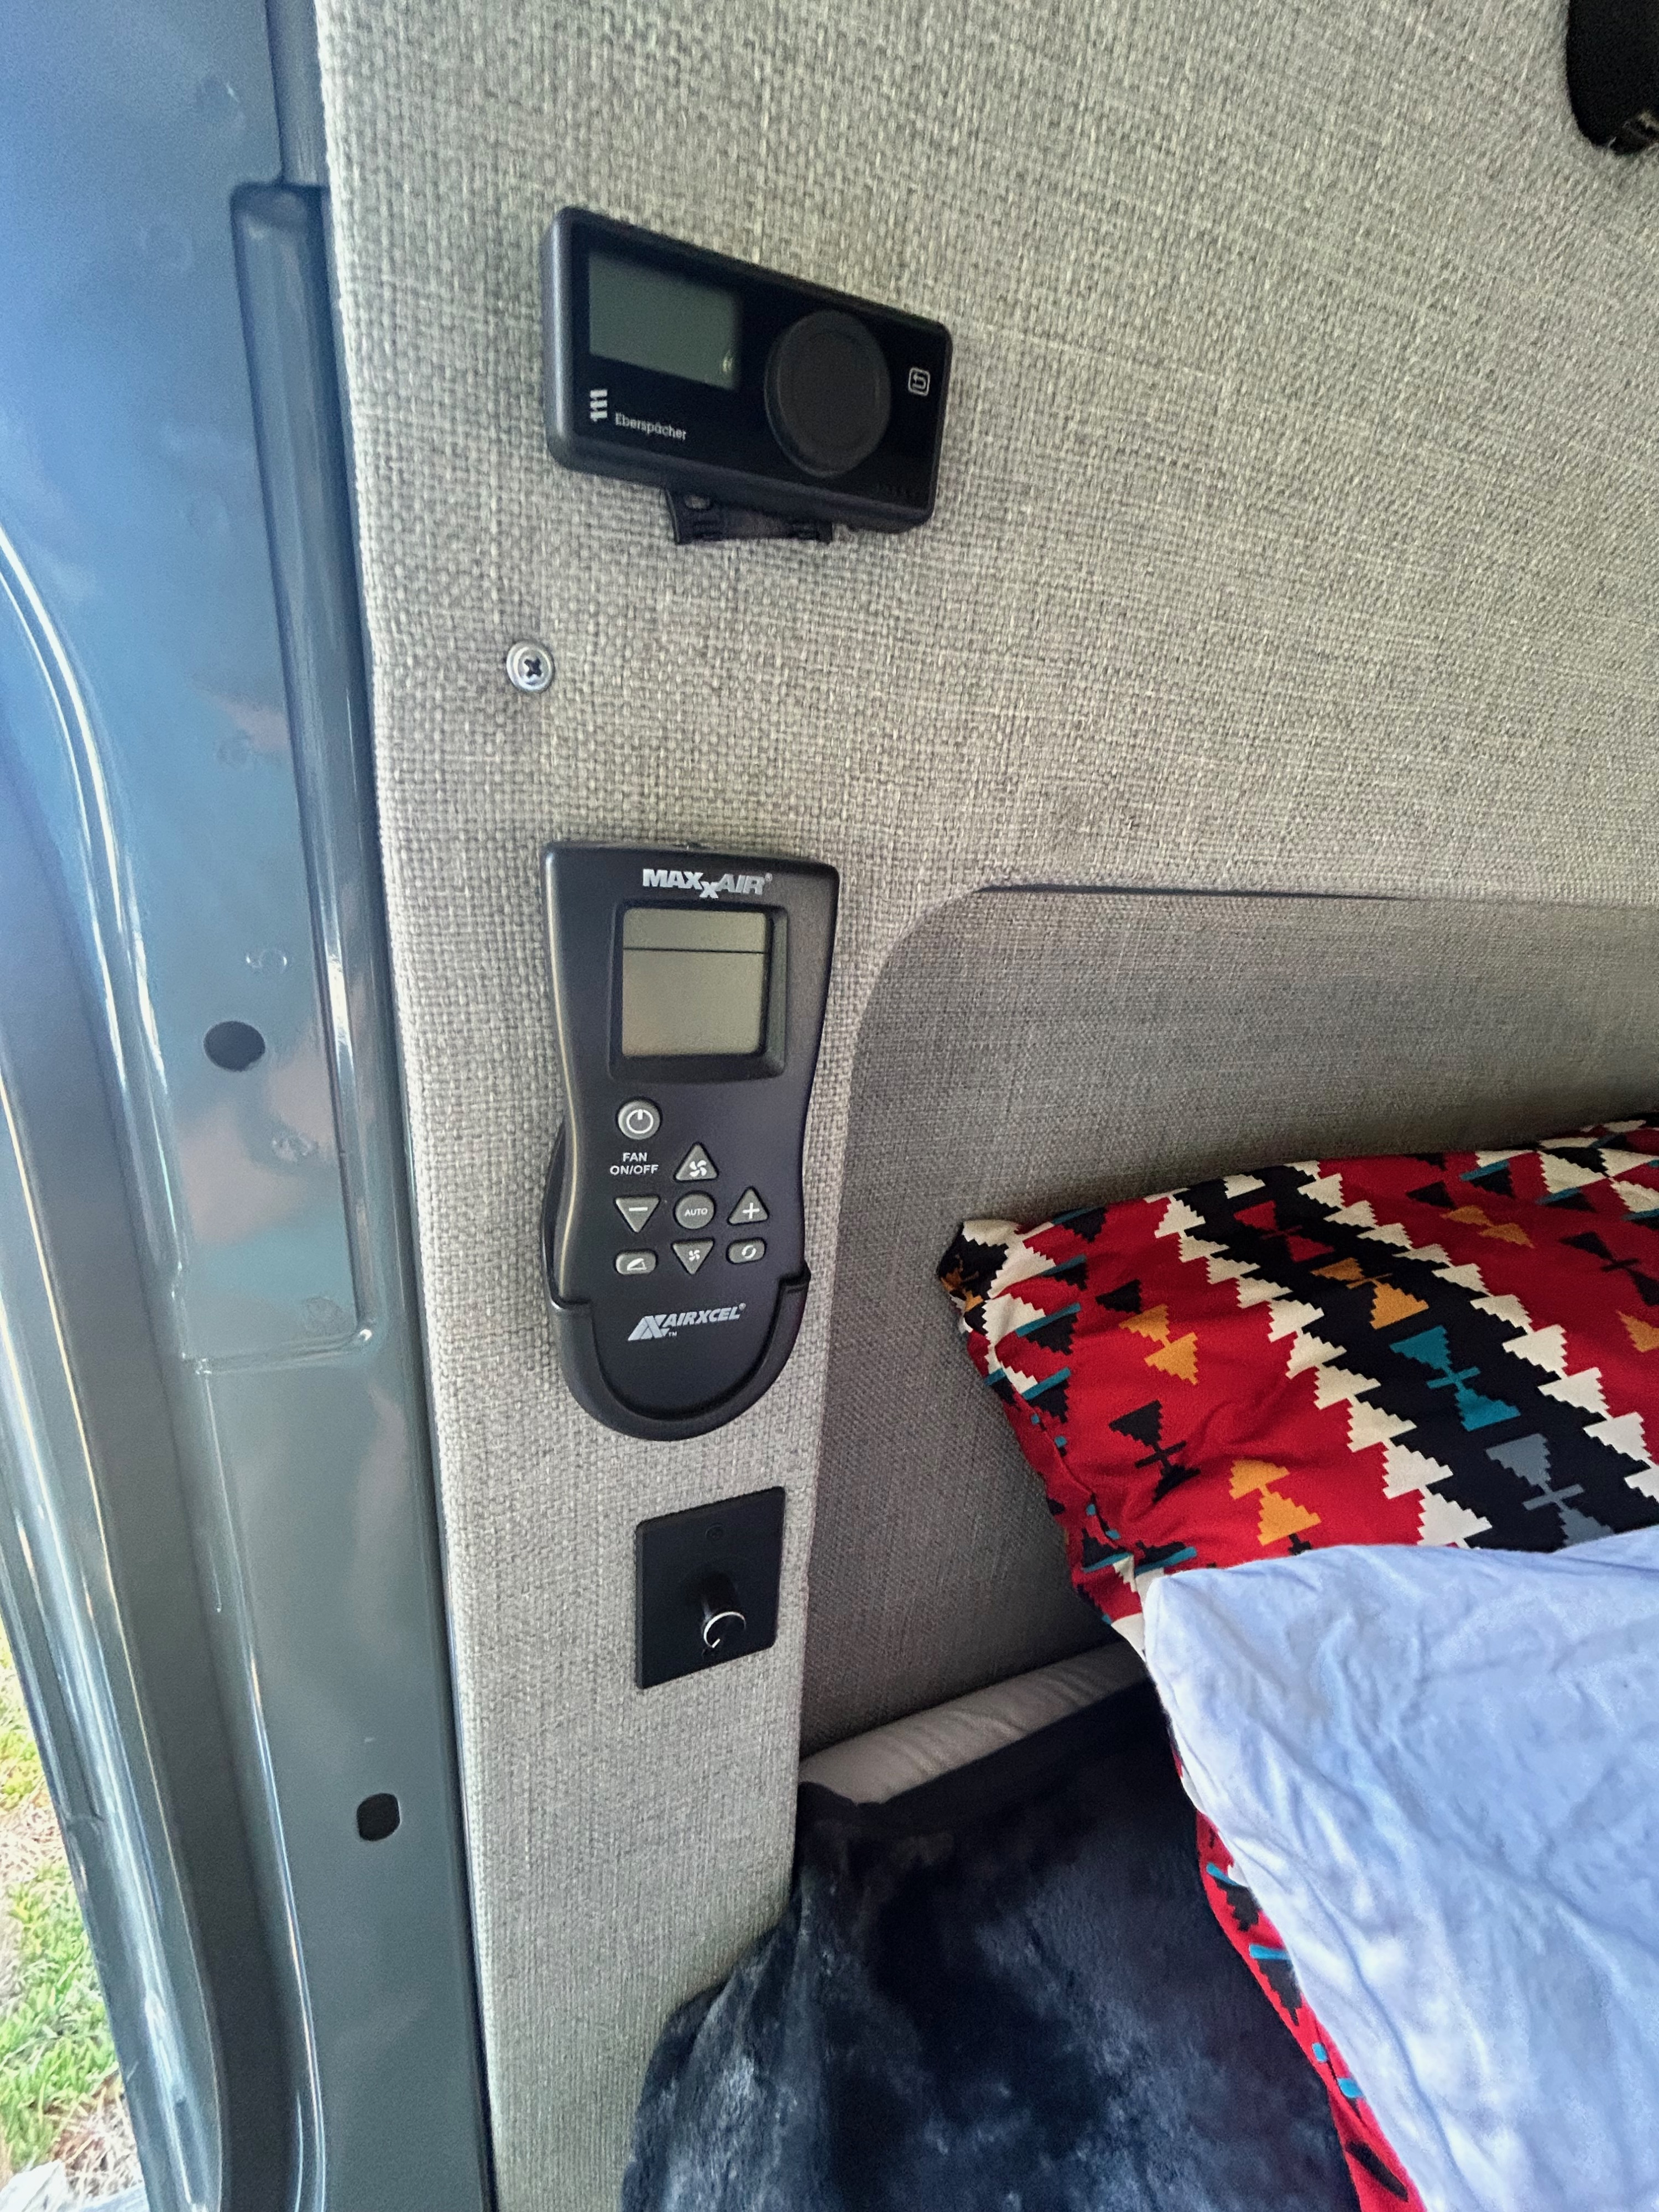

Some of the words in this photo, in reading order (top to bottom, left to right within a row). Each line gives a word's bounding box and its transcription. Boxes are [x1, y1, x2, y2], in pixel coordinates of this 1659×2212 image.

[623, 1152, 648, 1162] FAN
[610, 1164, 659, 1176] ON/OFF
[685, 1208, 708, 1217] AUTO
[662, 1306, 740, 1328] AIRXCEL
